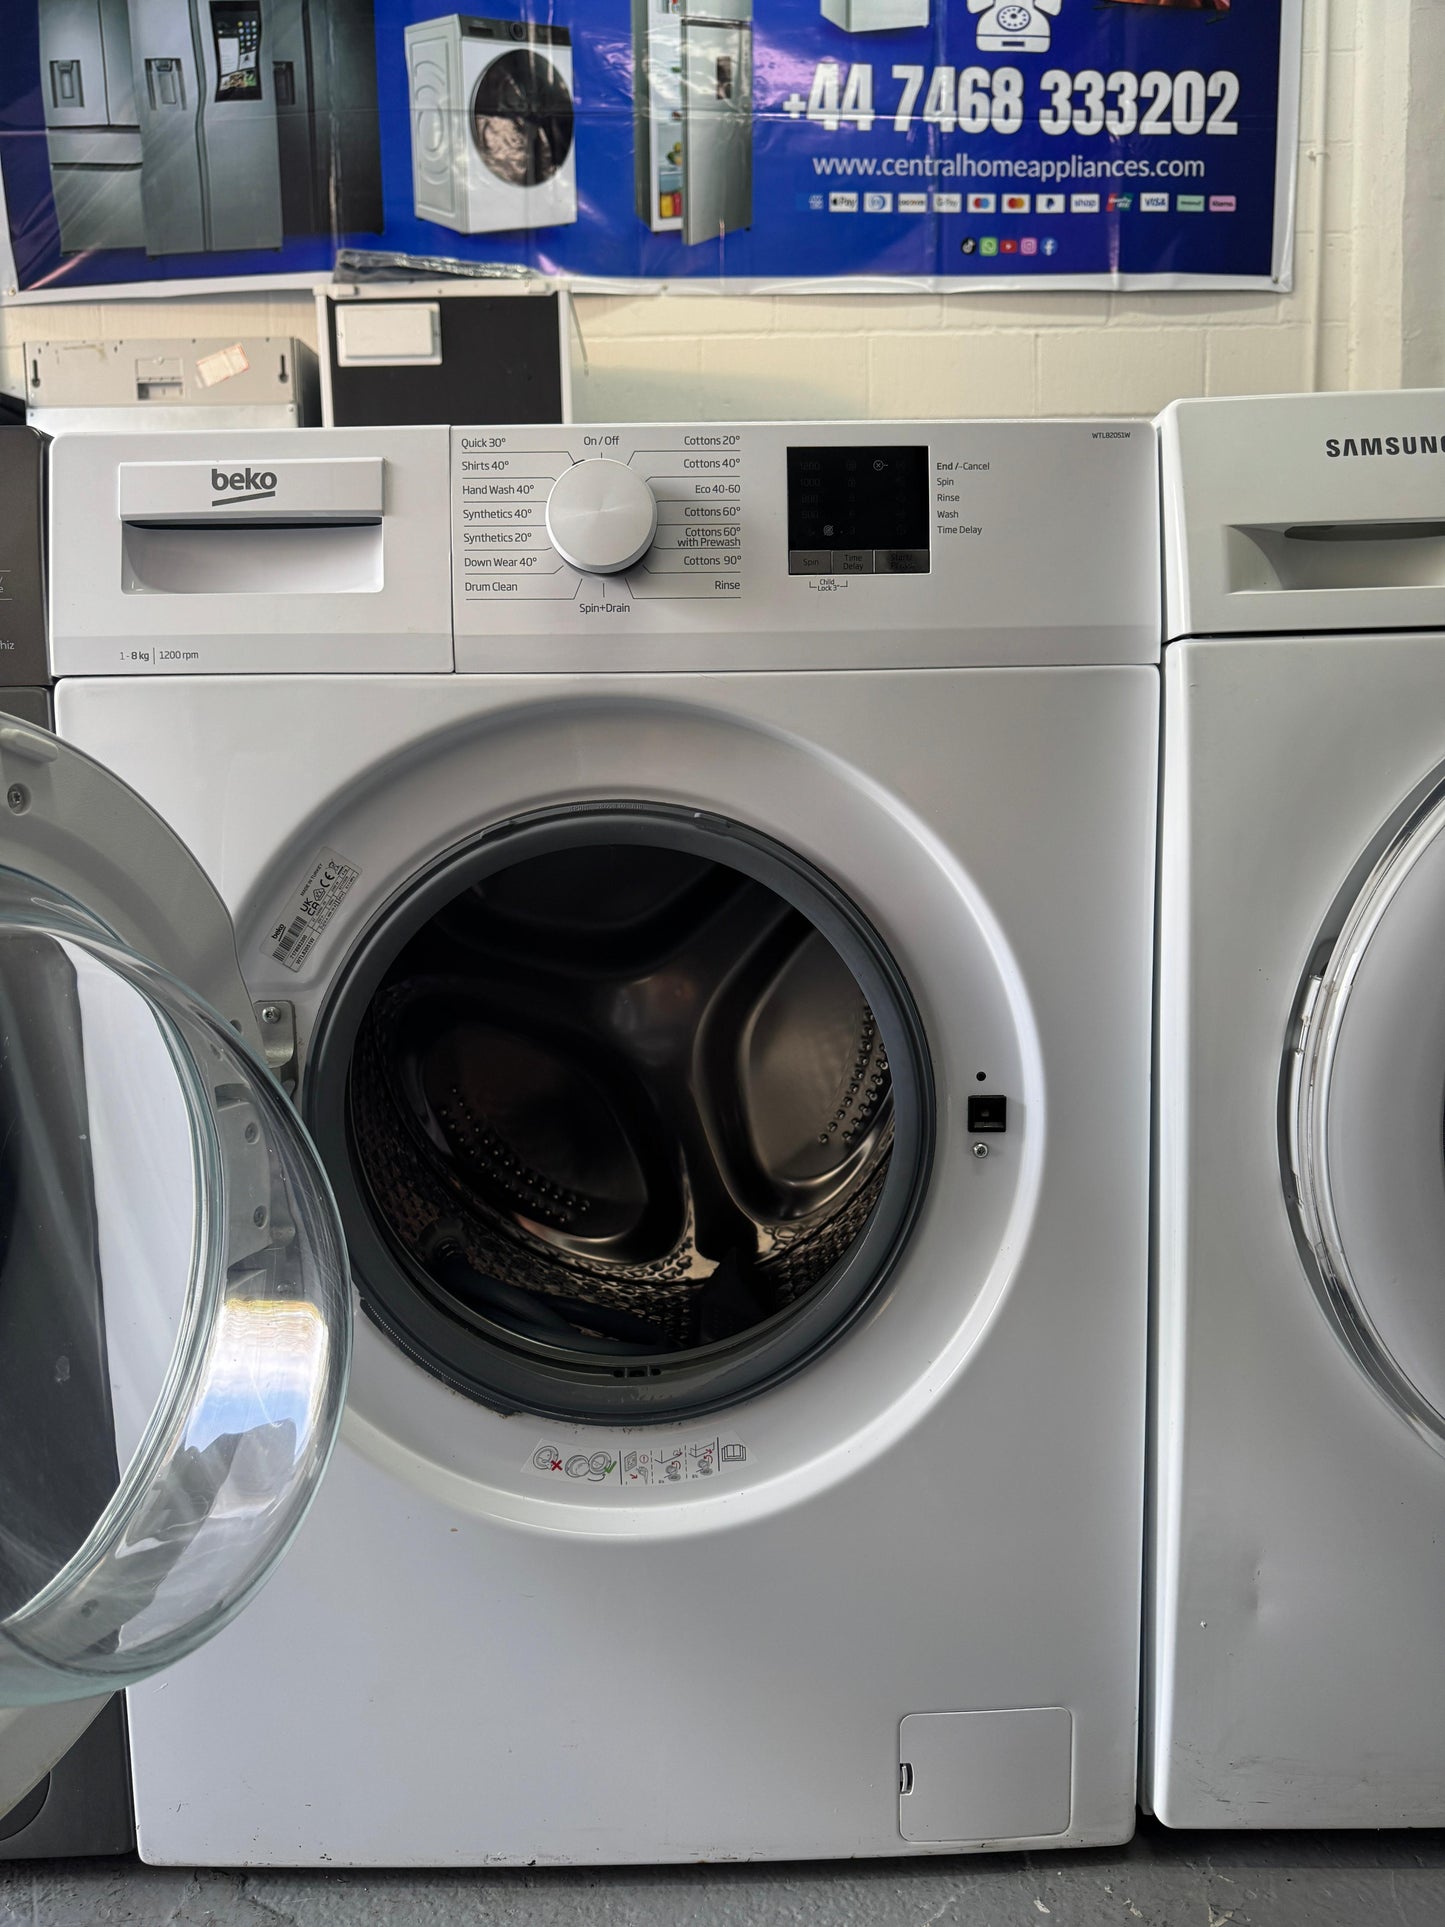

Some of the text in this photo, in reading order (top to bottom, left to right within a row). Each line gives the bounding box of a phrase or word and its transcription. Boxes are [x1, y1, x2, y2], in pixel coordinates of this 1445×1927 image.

[782, 63, 1240, 136] +44 7468 333202
[812, 153, 1205, 183] www.centralhomeappliances.com
[1091, 431, 1131, 439] WTL82051W
[461, 438, 506, 449] Quick 30°
[583, 436, 597, 446] On
[605, 435, 620, 446] Off
[684, 435, 741, 446] Cottons 20°
[462, 460, 509, 471] Shirts 40°
[683, 458, 741, 469] Cottons 40°
[936, 461, 953, 470] End
[211, 467, 278, 491] beko
[936, 477, 954, 487] Spin
[462, 484, 535, 495] Hand Wash 40°
[695, 484, 741, 494] Eco 40-60
[937, 494, 960, 502] Rinse
[463, 509, 532, 520] Synthetics 40°
[684, 506, 741, 517] Cottons 60°
[937, 510, 959, 519] Wash
[685, 527, 741, 537] Cottons 60°
[937, 525, 983, 535] Time Delay
[463, 533, 532, 544] Synthetics 20°
[677, 537, 741, 547] with Prewash
[464, 557, 538, 567] Down Wear 40°
[683, 556, 742, 566] Cottons 90°
[803, 557, 819, 567] Spin
[844, 553, 863, 562] Time
[842, 562, 864, 571] Delay
[464, 582, 518, 592] Drum Clean
[714, 580, 741, 590] Rinse
[817, 584, 832, 592] Lock
[579, 602, 631, 614] Spin+Drain
[131, 651, 138, 660] 8
[139, 651, 150, 662] kg
[159, 650, 199, 661] 1200 rpm
